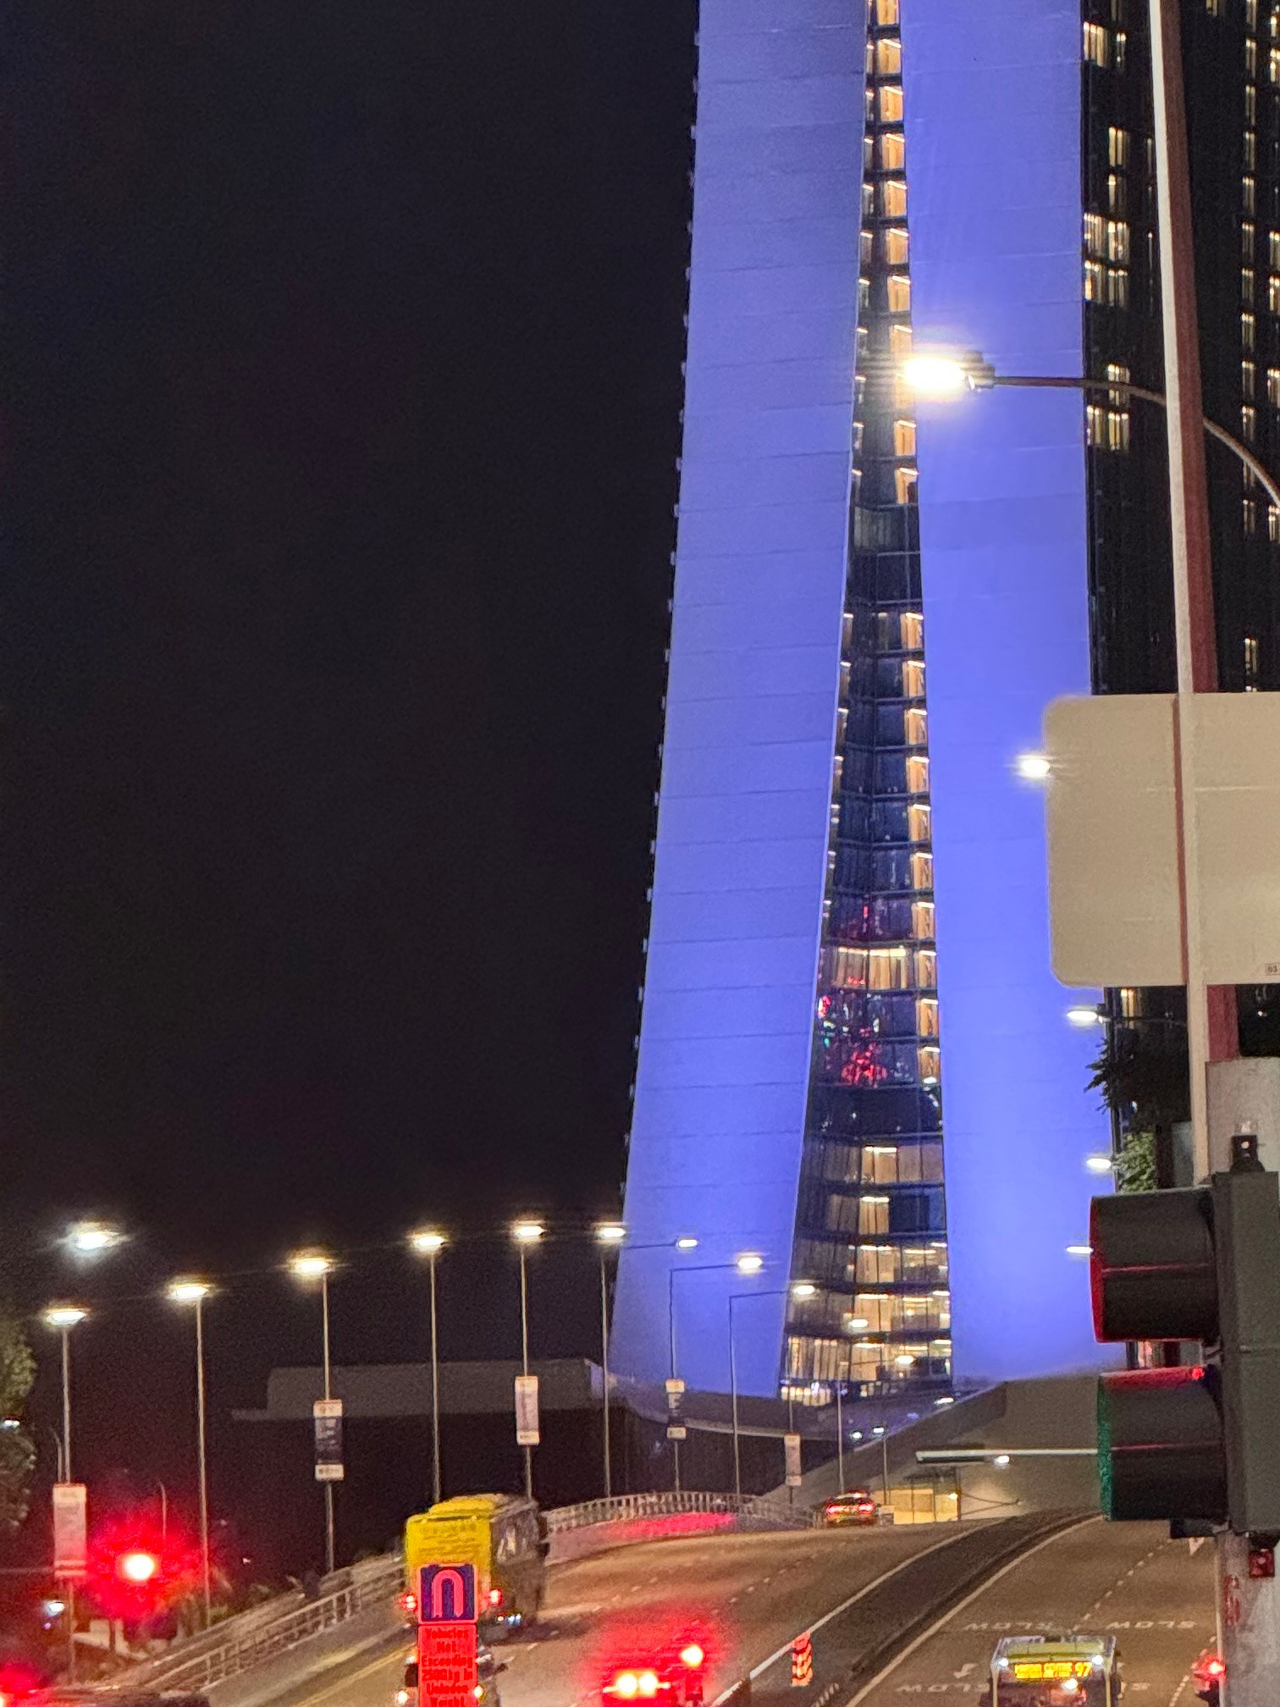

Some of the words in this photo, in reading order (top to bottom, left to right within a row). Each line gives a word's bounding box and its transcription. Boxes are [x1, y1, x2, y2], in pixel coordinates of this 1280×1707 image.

[436, 1641, 457, 1653] Not
[421, 1655, 473, 1669] Exceeding
[1074, 1661, 1093, 1677] 97
